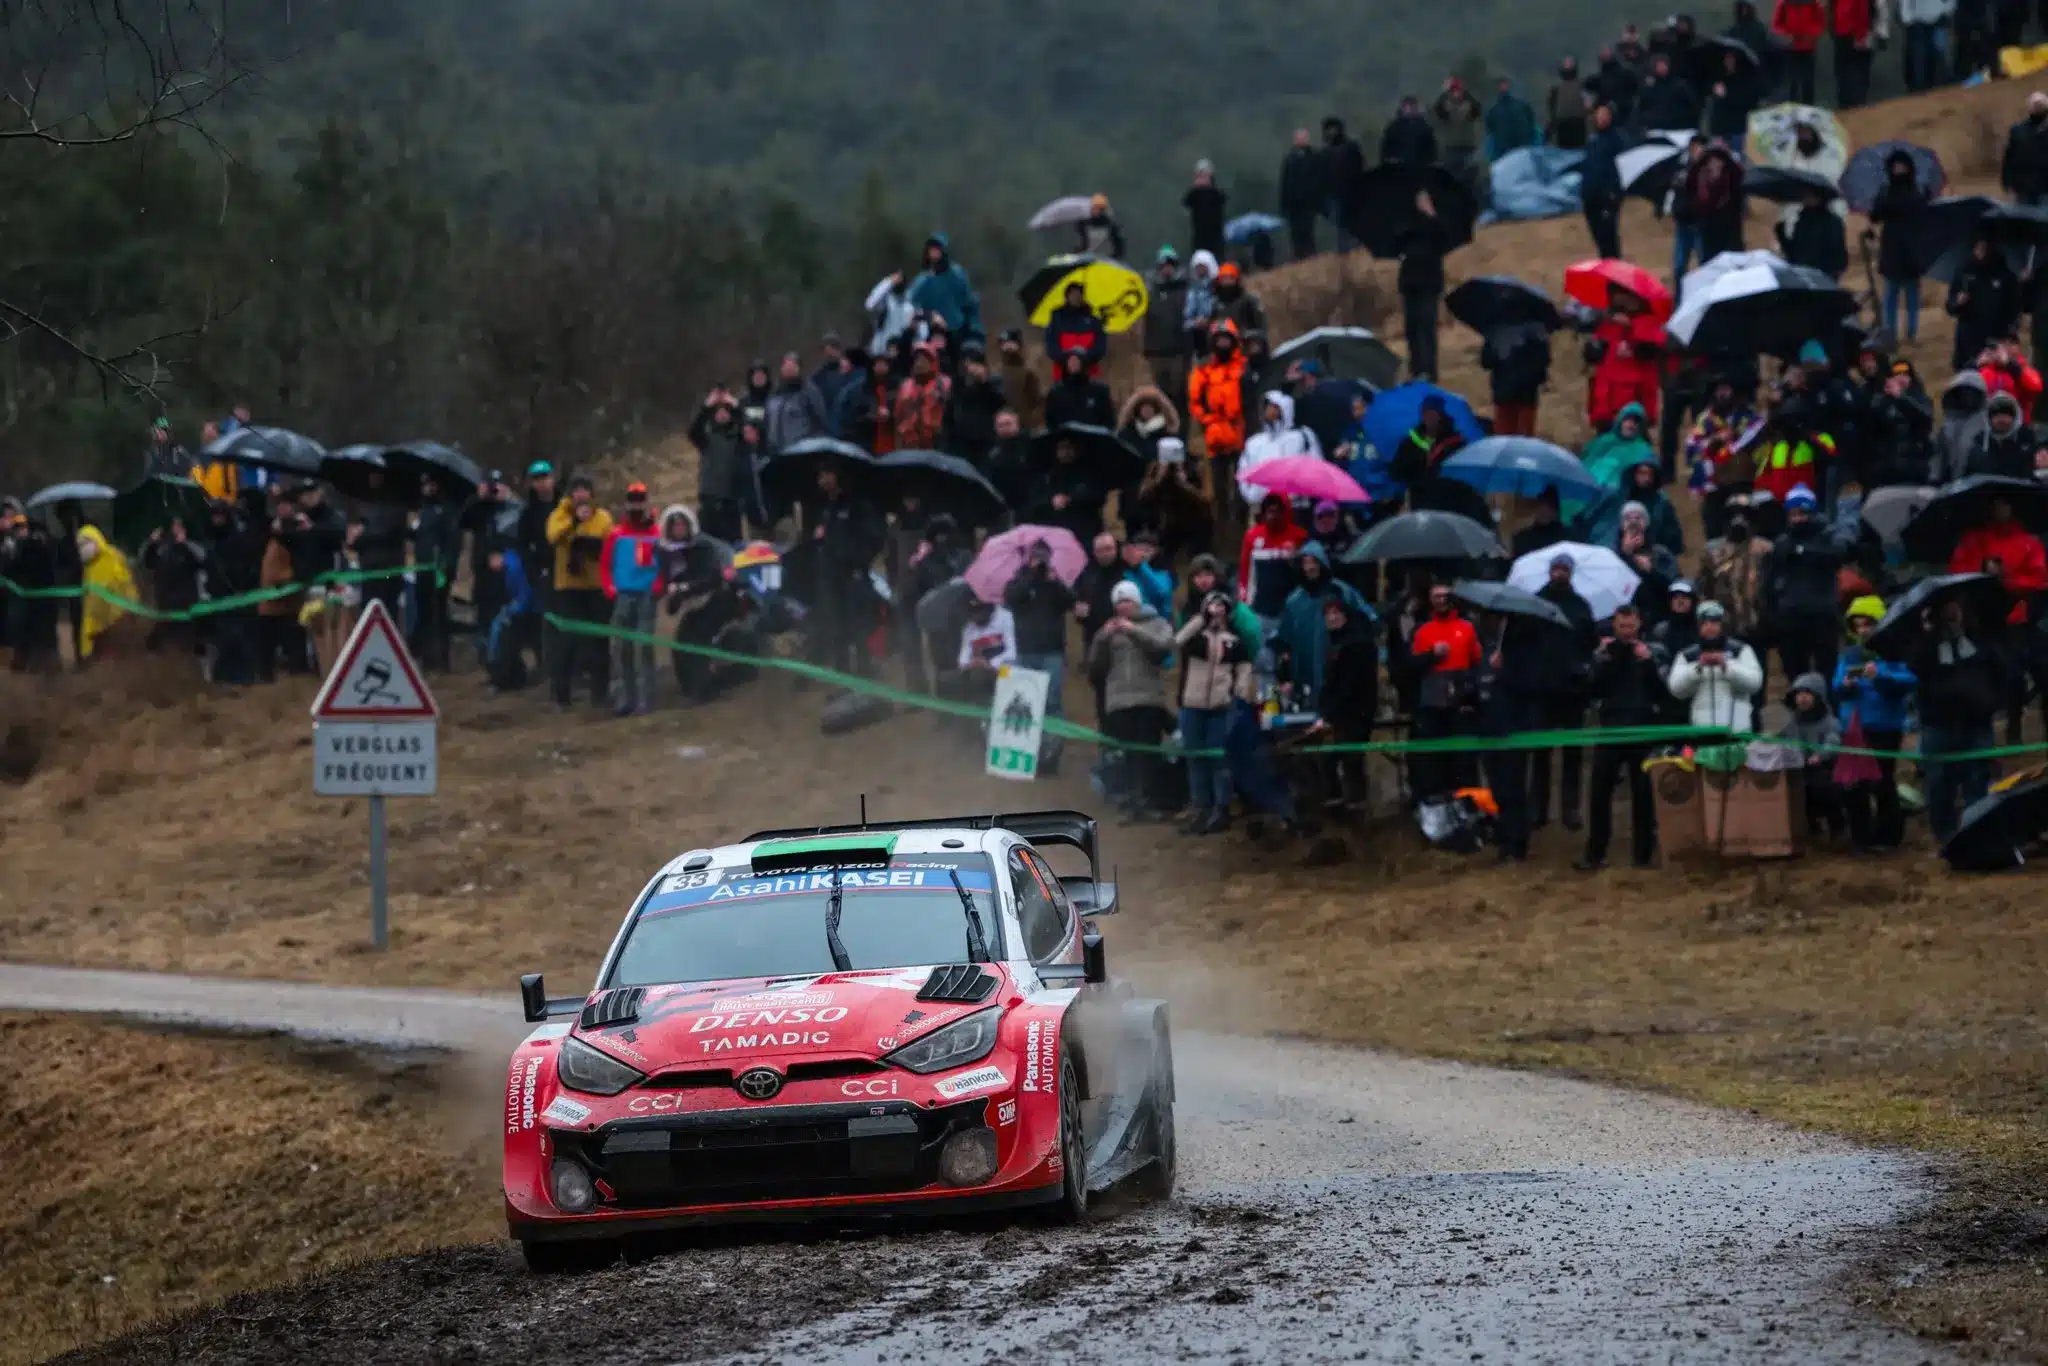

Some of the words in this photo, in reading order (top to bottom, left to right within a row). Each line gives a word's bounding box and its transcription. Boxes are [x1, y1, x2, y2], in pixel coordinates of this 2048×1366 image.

[332, 736, 422, 754] VERGLAS
[324, 761, 427, 781] FRÉQUENT
[673, 871, 710, 890] 33
[728, 866, 807, 880] TOYOTA
[890, 861, 958, 871] Racing
[689, 1007, 849, 1034] DENSO
[699, 1031, 831, 1053] TAMADIC
[1023, 1020, 1041, 1092] Panasonic
[1042, 1019, 1056, 1094] AUTOMOTIVE
[508, 1058, 523, 1134] AUTOMOTIVE
[523, 1056, 544, 1129] Panasonic
